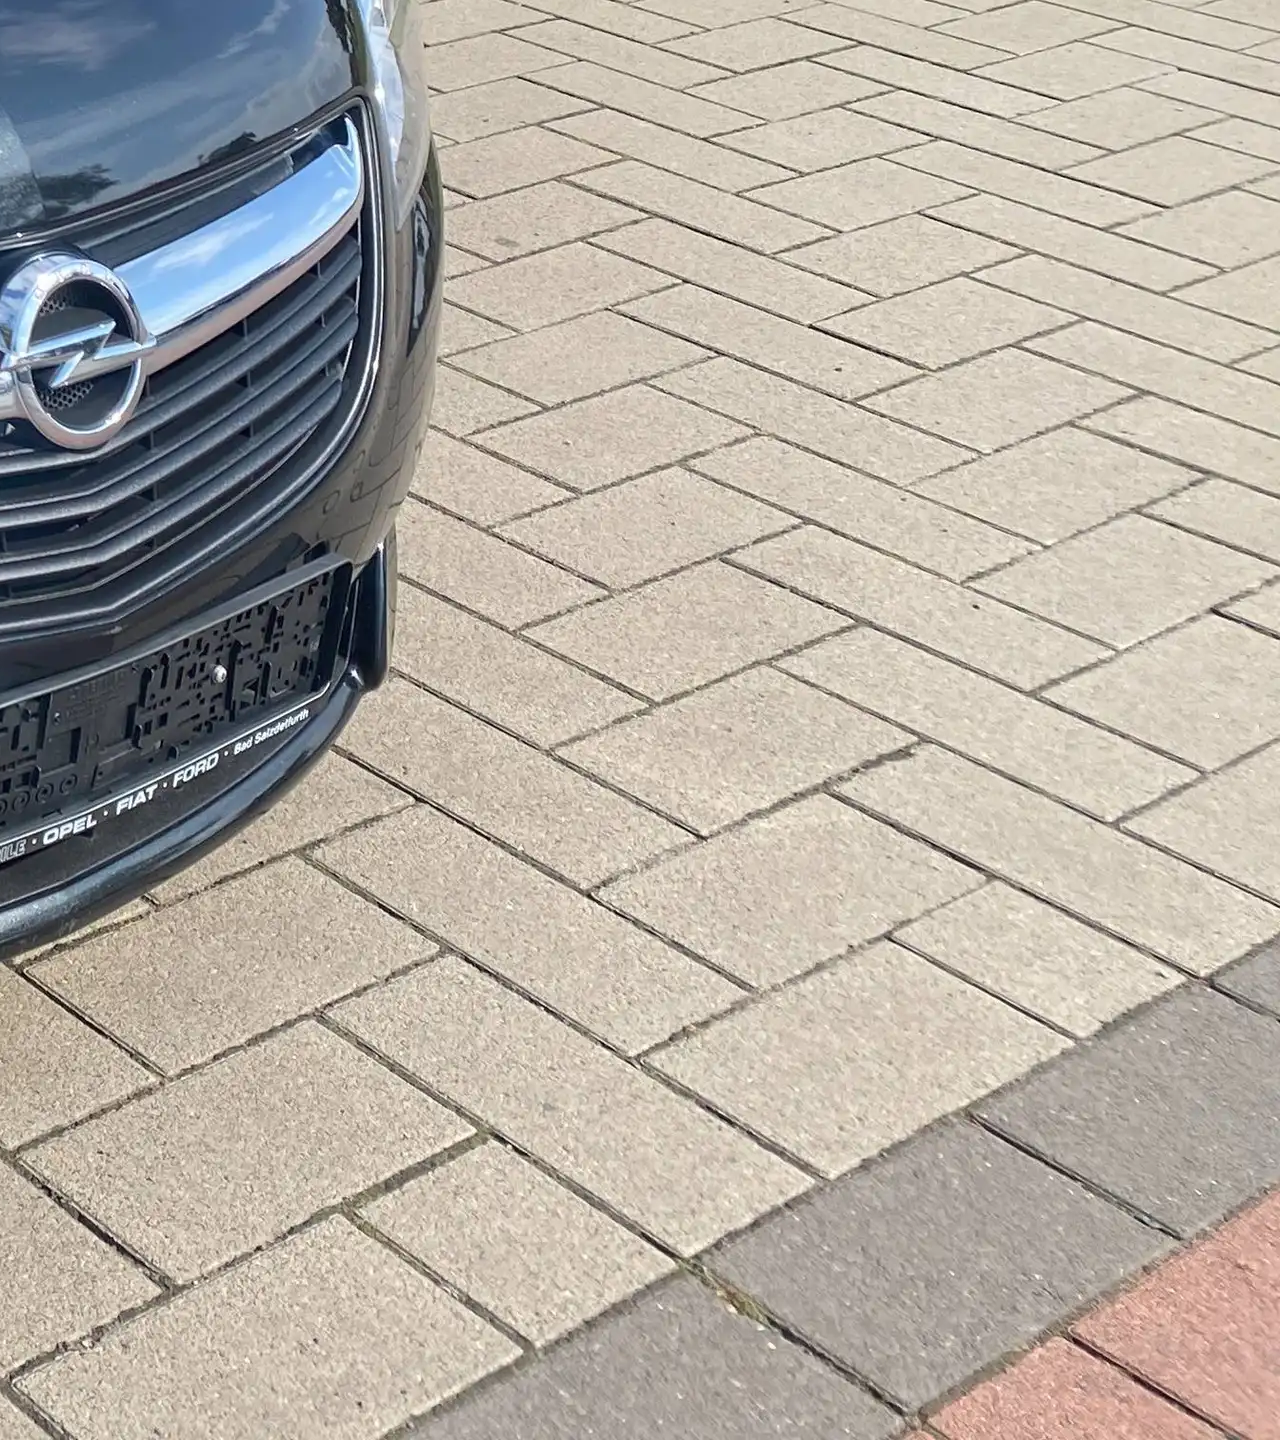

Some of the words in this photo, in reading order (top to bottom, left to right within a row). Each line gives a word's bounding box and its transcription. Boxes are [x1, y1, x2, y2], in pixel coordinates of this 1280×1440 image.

[42, 817, 97, 846] OPEL
[116, 784, 159, 815] FIAT
[172, 752, 221, 788] FORD
[233, 738, 254, 756] Bad
